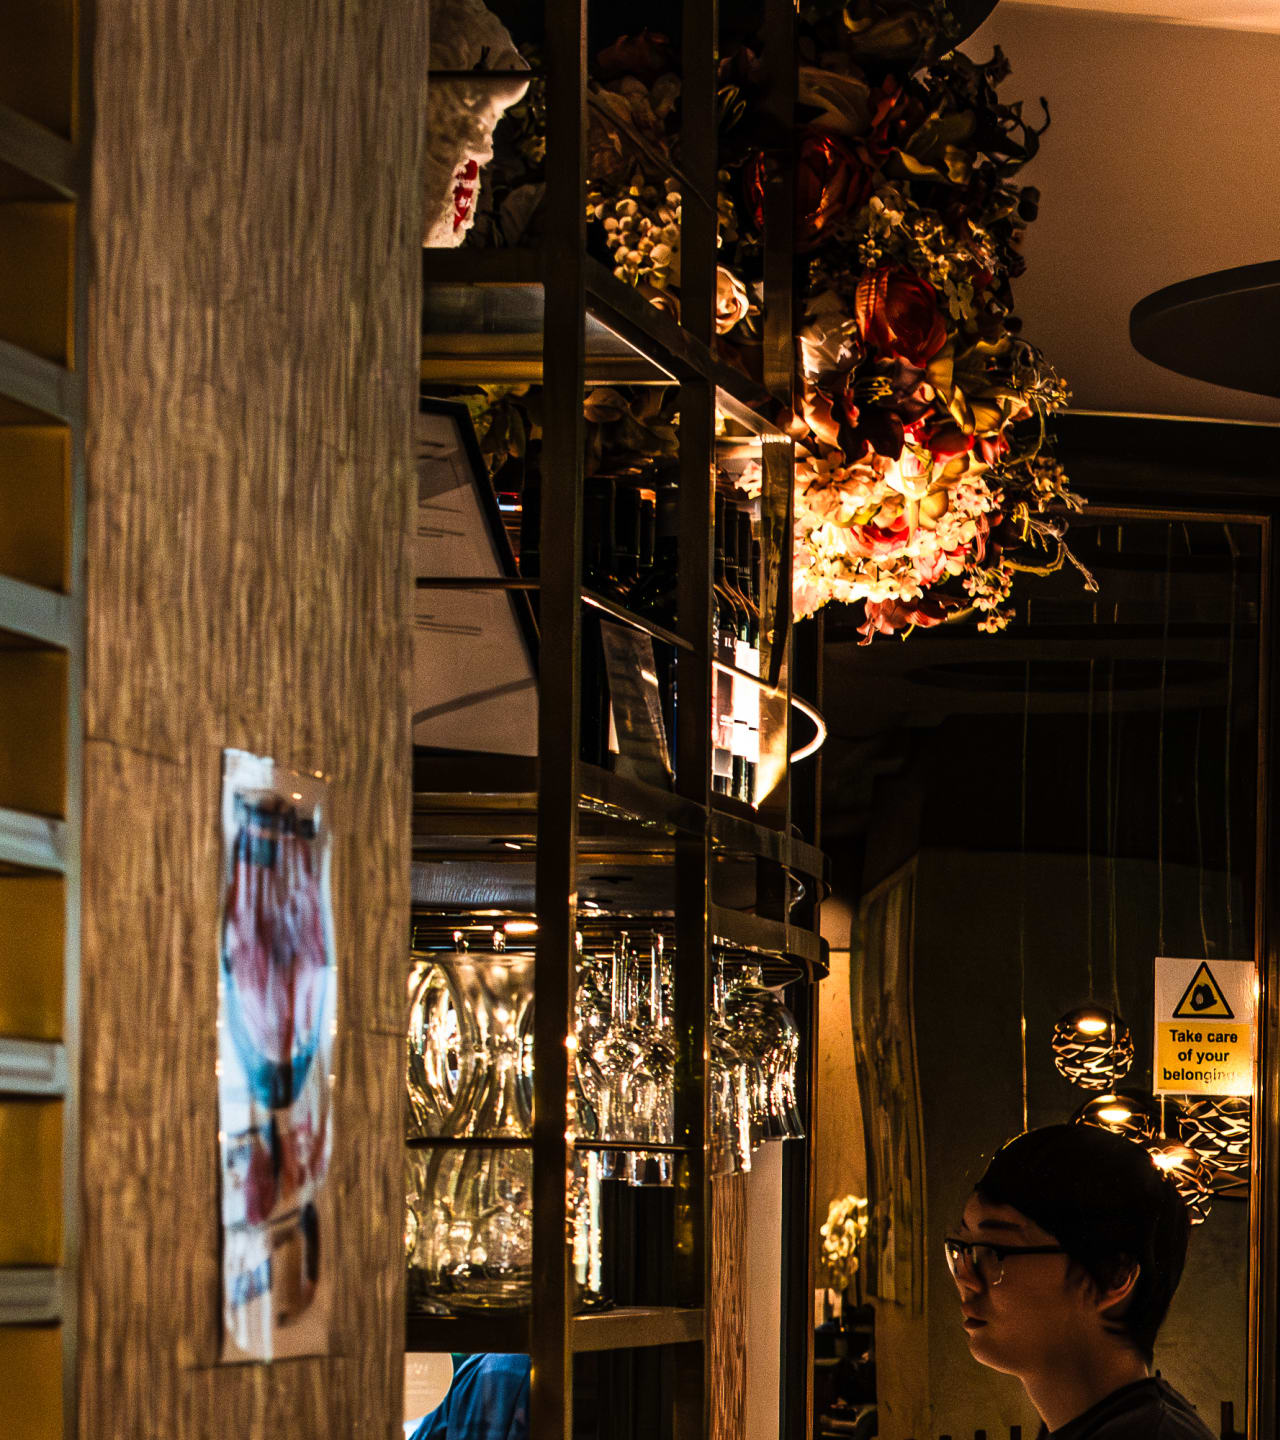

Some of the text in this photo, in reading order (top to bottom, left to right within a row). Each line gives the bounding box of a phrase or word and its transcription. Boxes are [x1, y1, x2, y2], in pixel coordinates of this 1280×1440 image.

[1169, 1029, 1238, 1044] Take care
[1178, 1048, 1230, 1064] of your
